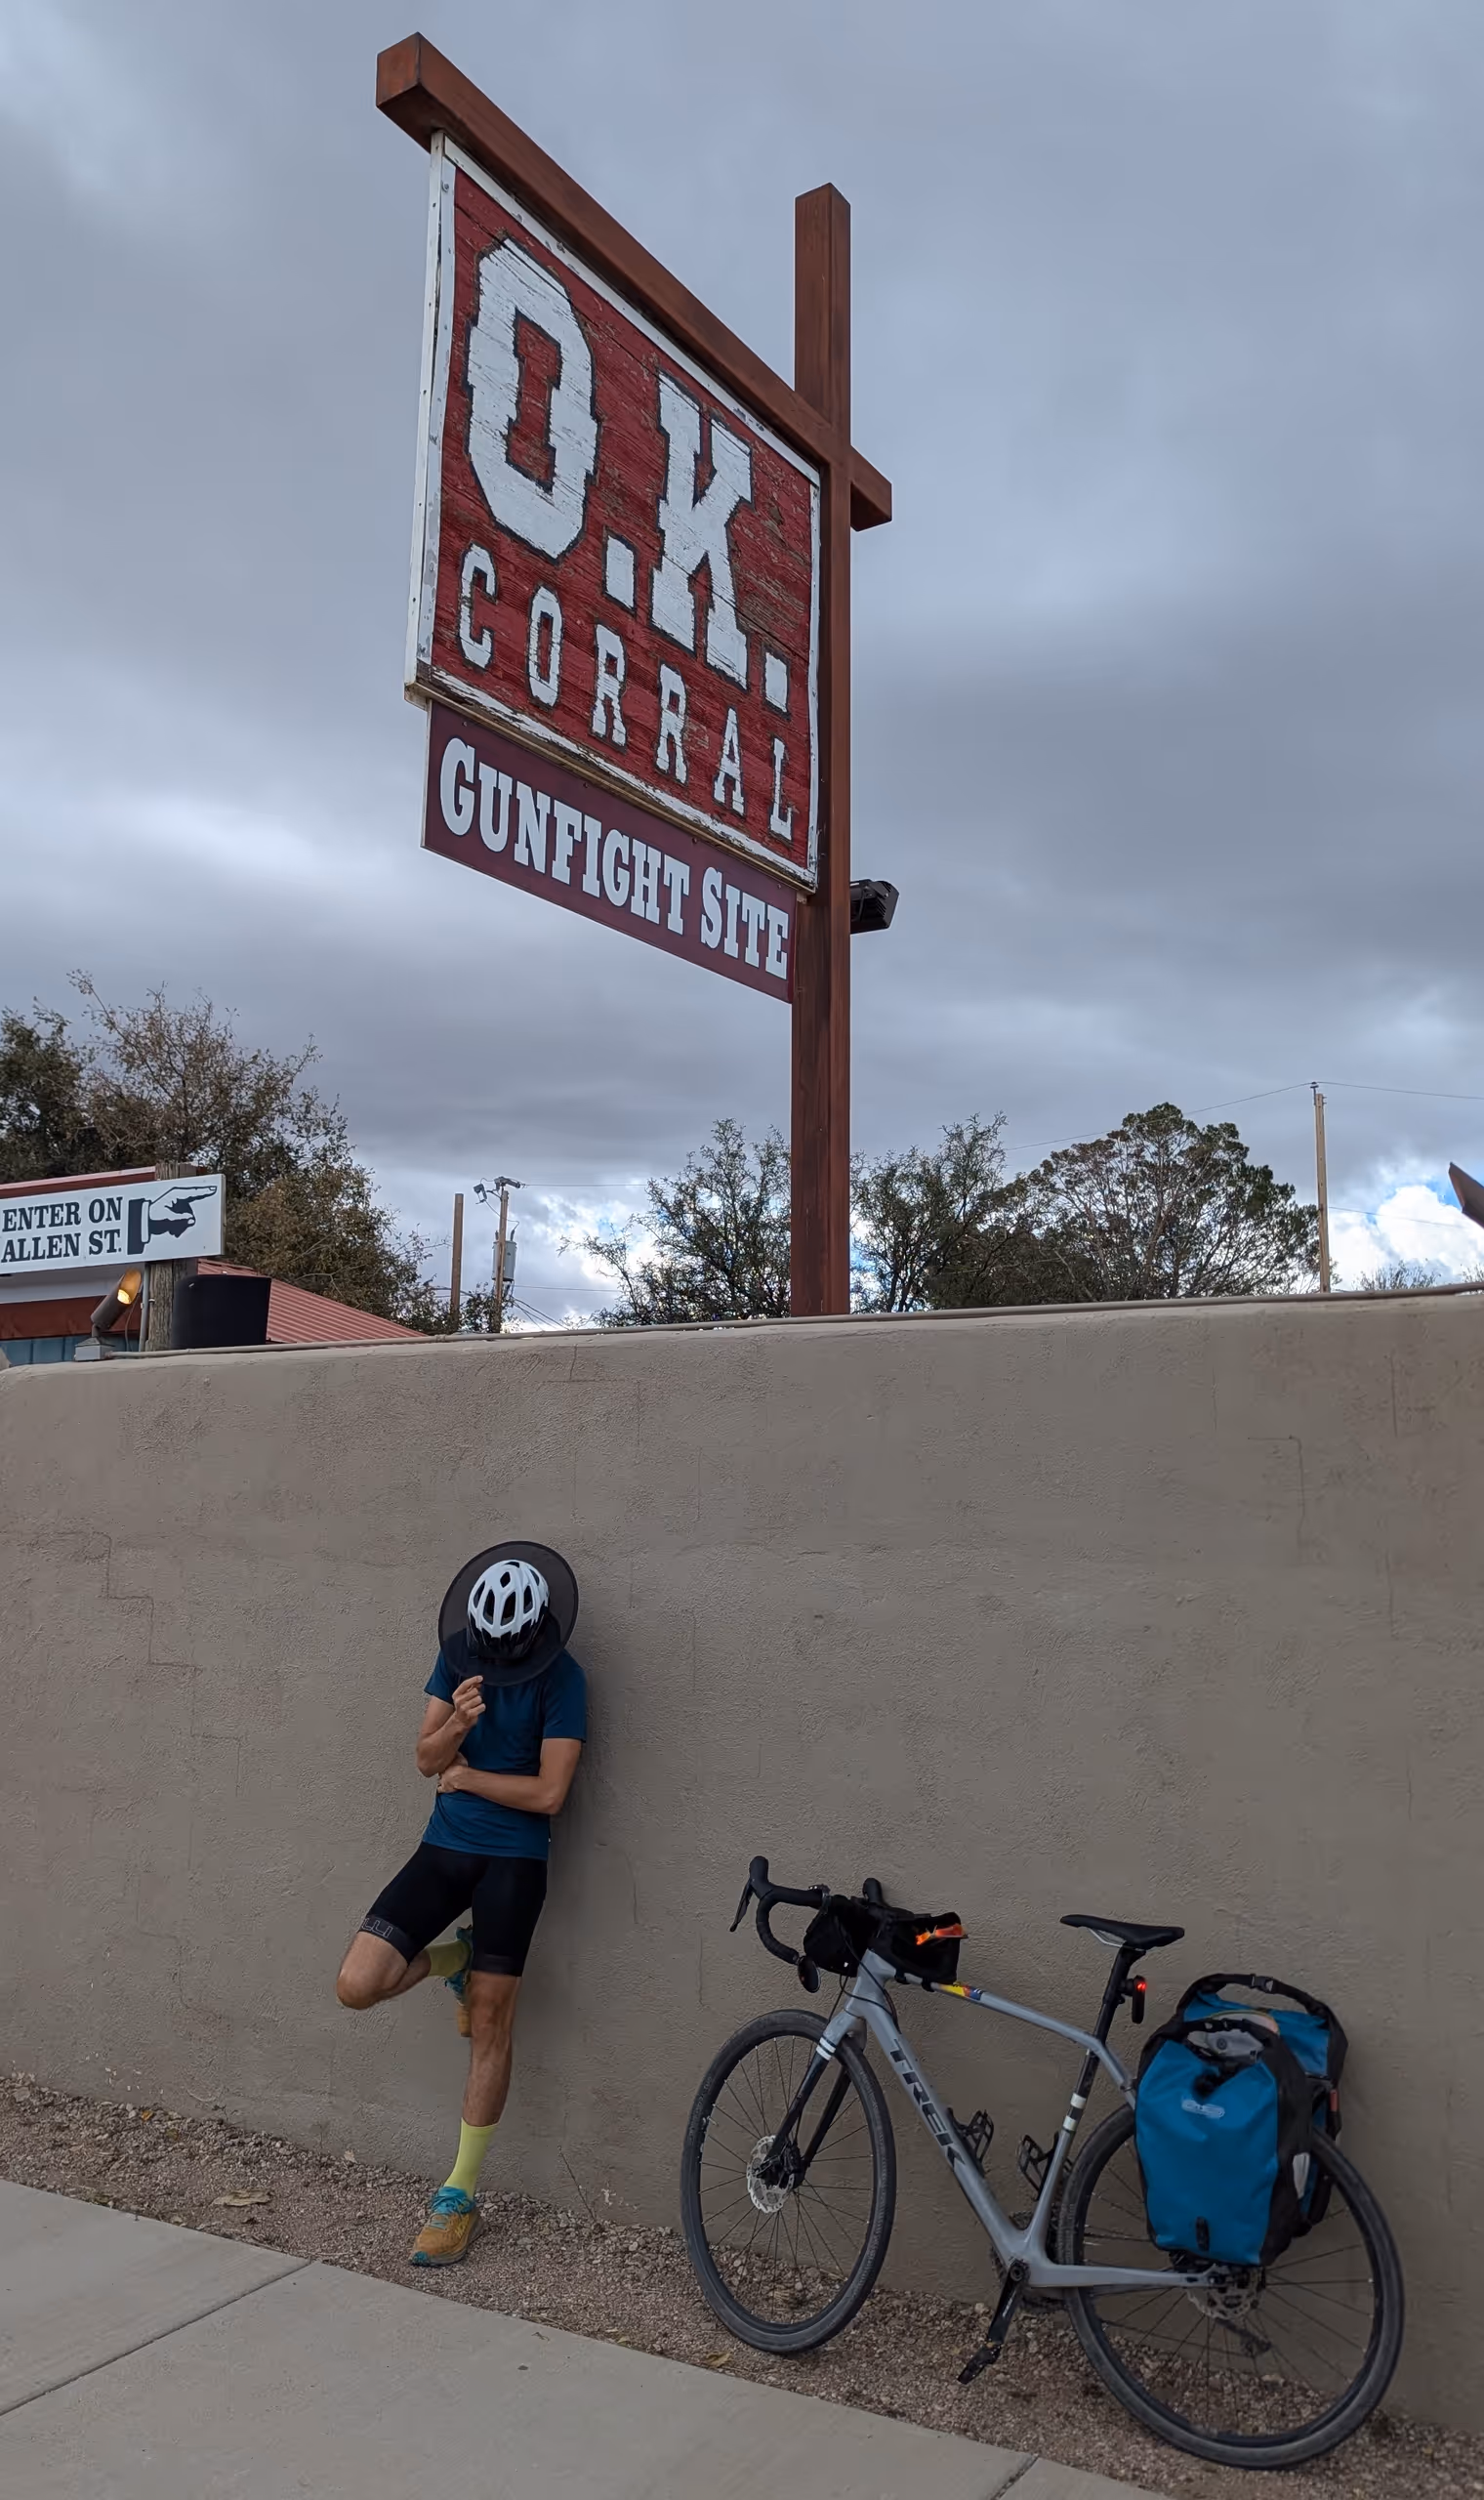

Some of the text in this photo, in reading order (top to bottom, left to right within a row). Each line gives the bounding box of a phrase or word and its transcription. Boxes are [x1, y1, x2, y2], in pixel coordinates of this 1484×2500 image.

[465, 236, 789, 715] O.K.
[459, 543, 794, 842] CORRAL
[439, 736, 790, 980] GUNFIGHT SITE
[1, 1229, 122, 1263] ALLEN ST.
[2, 1196, 123, 1232] ENTER ON
[889, 2037, 966, 2168] TREK
